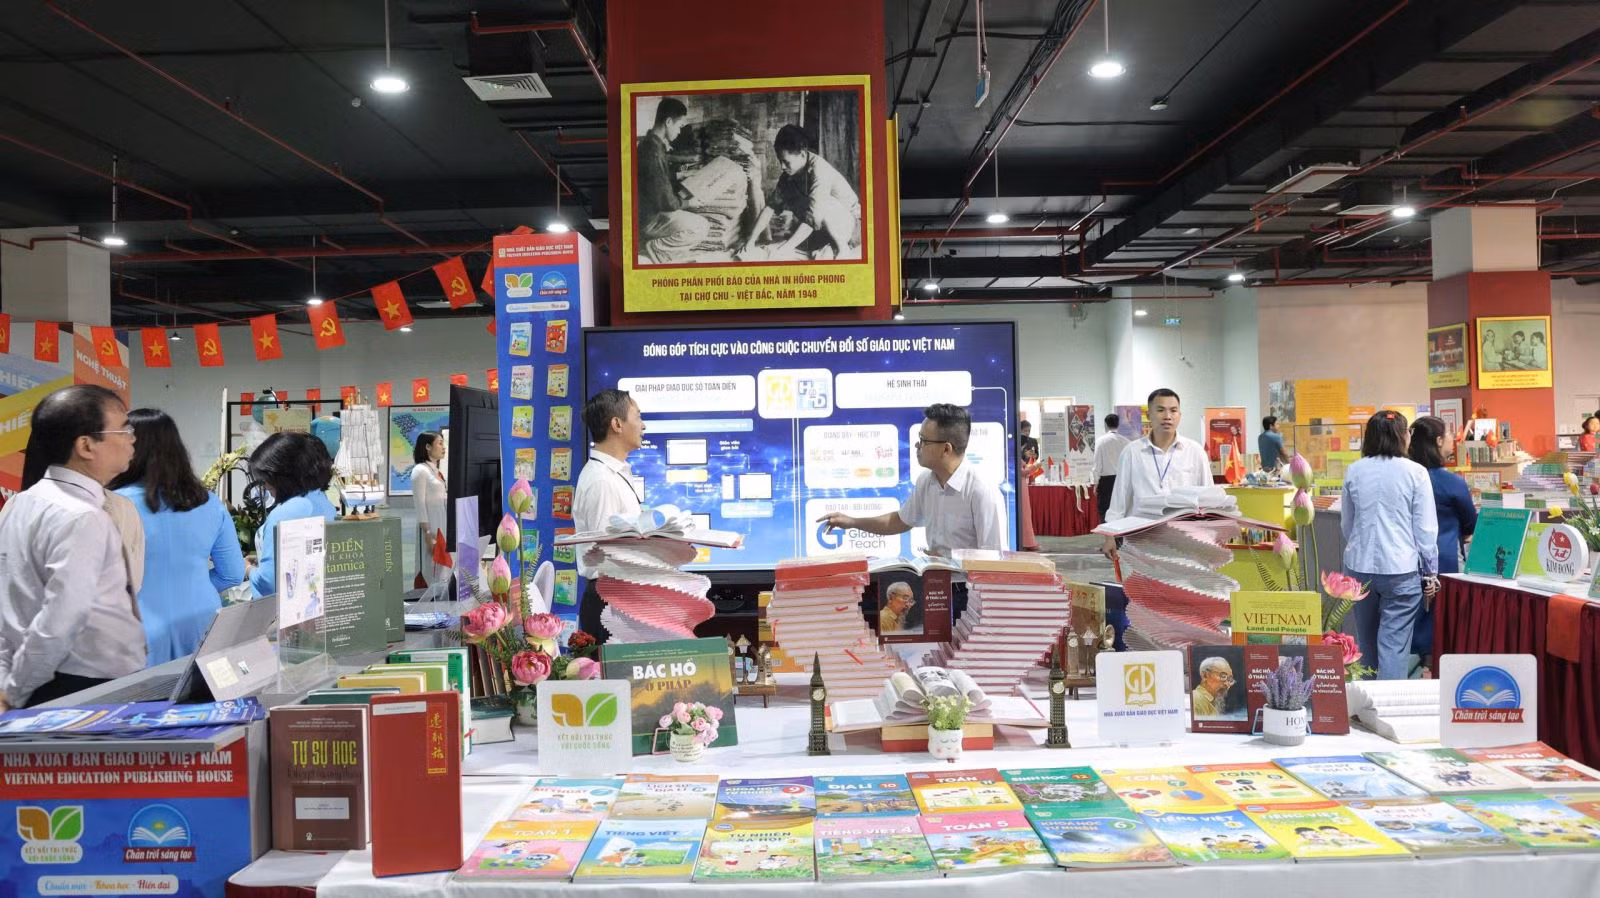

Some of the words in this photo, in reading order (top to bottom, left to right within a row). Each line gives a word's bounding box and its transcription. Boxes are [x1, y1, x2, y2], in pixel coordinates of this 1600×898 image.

[727, 275, 743, 287] BÁO
[782, 275, 791, 286] IN
[680, 292, 692, 304] TẠI
[694, 291, 711, 303] CHỢ
[713, 291, 729, 301] CHU
[736, 289, 753, 302] VIỆT
[776, 289, 796, 300] NĂM
[798, 289, 818, 300] 1948
[643, 342, 668, 357] ĐÓNG
[670, 341, 687, 357] GÓP
[688, 341, 709, 357] TÍCH
[711, 341, 728, 358] CỰC
[730, 340, 749, 356] VÀO
[750, 339, 774, 355] CÔNG
[776, 339, 799, 356] CUỘC
[801, 336, 837, 354] CHUYỂN
[839, 335, 854, 353] ĐỔI
[856, 336, 870, 353] SỐ
[870, 337, 891, 352] GIÁO
[893, 338, 911, 354] DỤC
[912, 336, 932, 354] VIỆT
[934, 338, 955, 351] NAM
[76, 349, 100, 375] NGHỆ
[101, 366, 128, 391] THUẬT
[897, 378, 912, 389] SINH
[850, 539, 887, 550] Teach
[1243, 612, 1312, 626] VIETNAM
[1281, 626, 1308, 634] People
[632, 659, 666, 681] BÁC
[669, 657, 697, 678] HỒ
[657, 677, 692, 692] PHÁP
[1455, 710, 1473, 721] Chân
[1474, 709, 1488, 721] trời
[1488, 711, 1507, 723] sáng
[1507, 711, 1520, 723] tạo
[201, 751, 232, 765] NAM
[291, 739, 307, 769] TỰ
[312, 739, 328, 769] SỰ
[333, 740, 357, 769] HỌC
[5, 771, 54, 785] VIETNAM
[57, 771, 120, 785] EDUCATION
[124, 770, 193, 784] PUBLISHING
[197, 769, 233, 783] HOUSE
[936, 776, 978, 784] TOÁN
[858, 782, 872, 790] LÍ
[901, 826, 914, 834] 4
[942, 821, 994, 832] TOÁN
[996, 820, 1009, 828] 5
[1112, 820, 1128, 829] 6
[513, 828, 556, 838] TOÁN
[564, 828, 572, 836] 1
[126, 848, 145, 860] Chân
[146, 848, 159, 860] trời
[160, 848, 179, 863] sáng
[179, 849, 192, 863] tạo
[137, 878, 157, 891] Hiện
